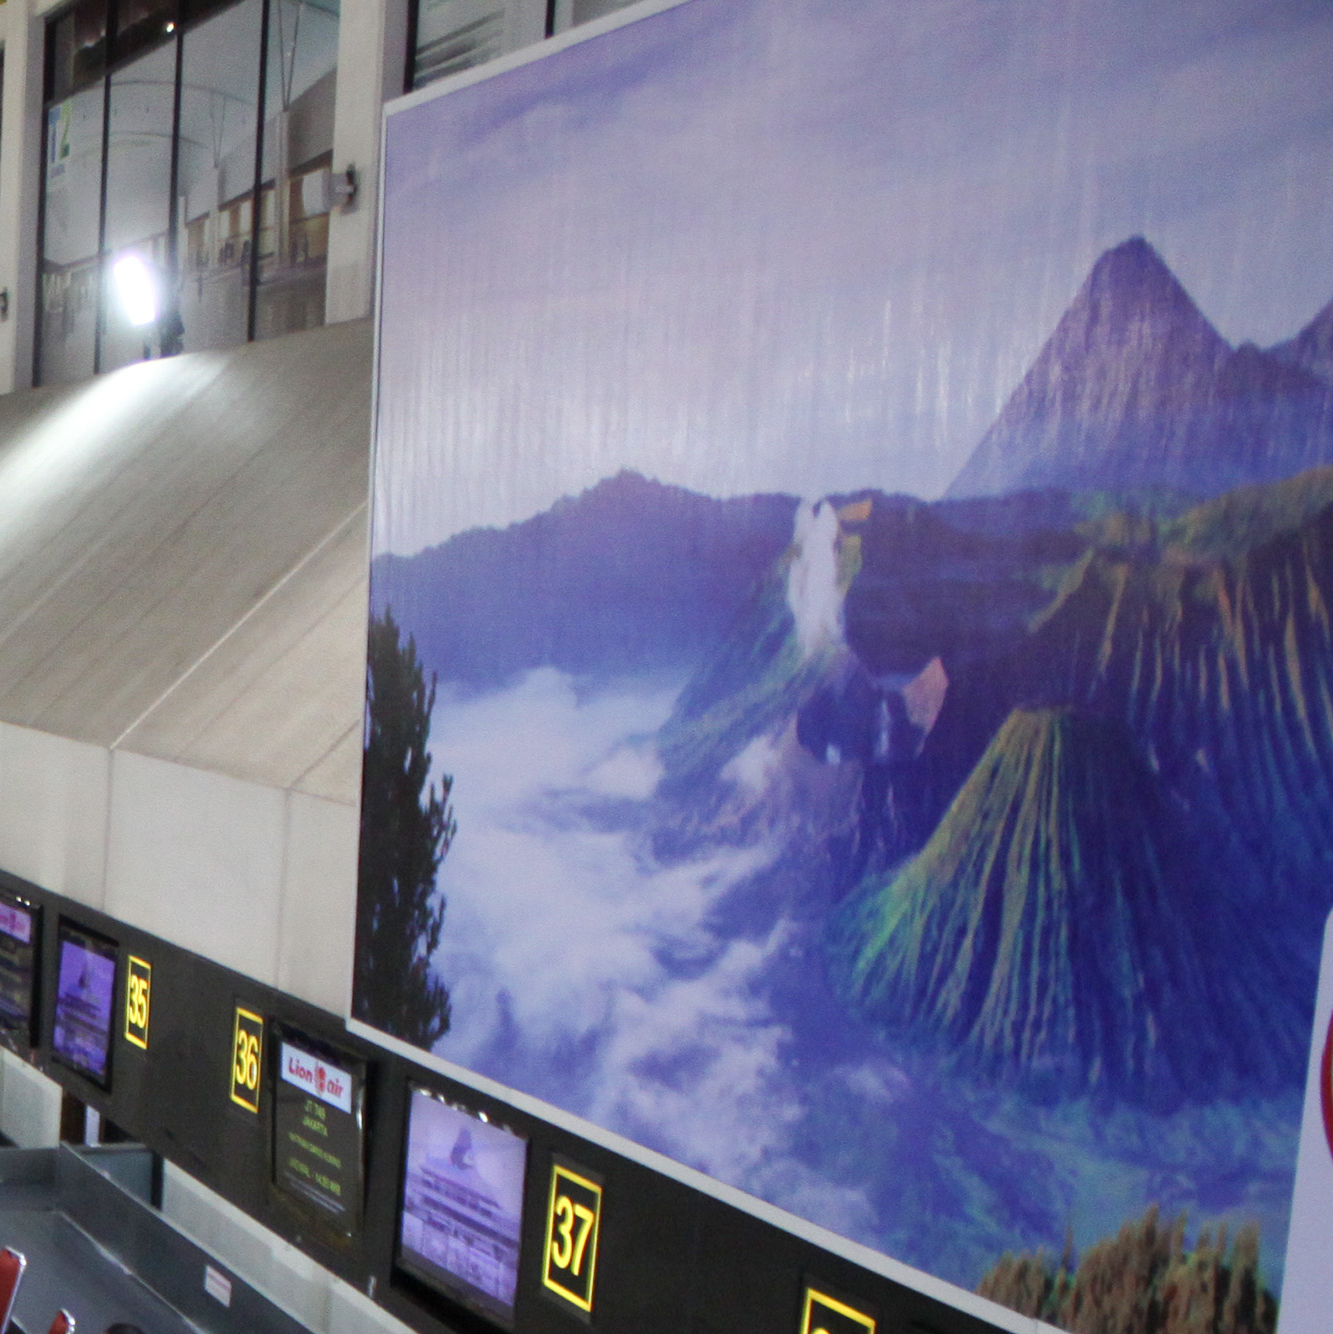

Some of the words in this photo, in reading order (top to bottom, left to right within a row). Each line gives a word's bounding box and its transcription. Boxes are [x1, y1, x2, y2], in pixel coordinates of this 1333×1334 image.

[129, 974, 149, 1029] 35
[235, 1029, 259, 1091] 36
[288, 1056, 313, 1084] Lion
[326, 1077, 344, 1099] air
[551, 1195, 595, 1276] 37
